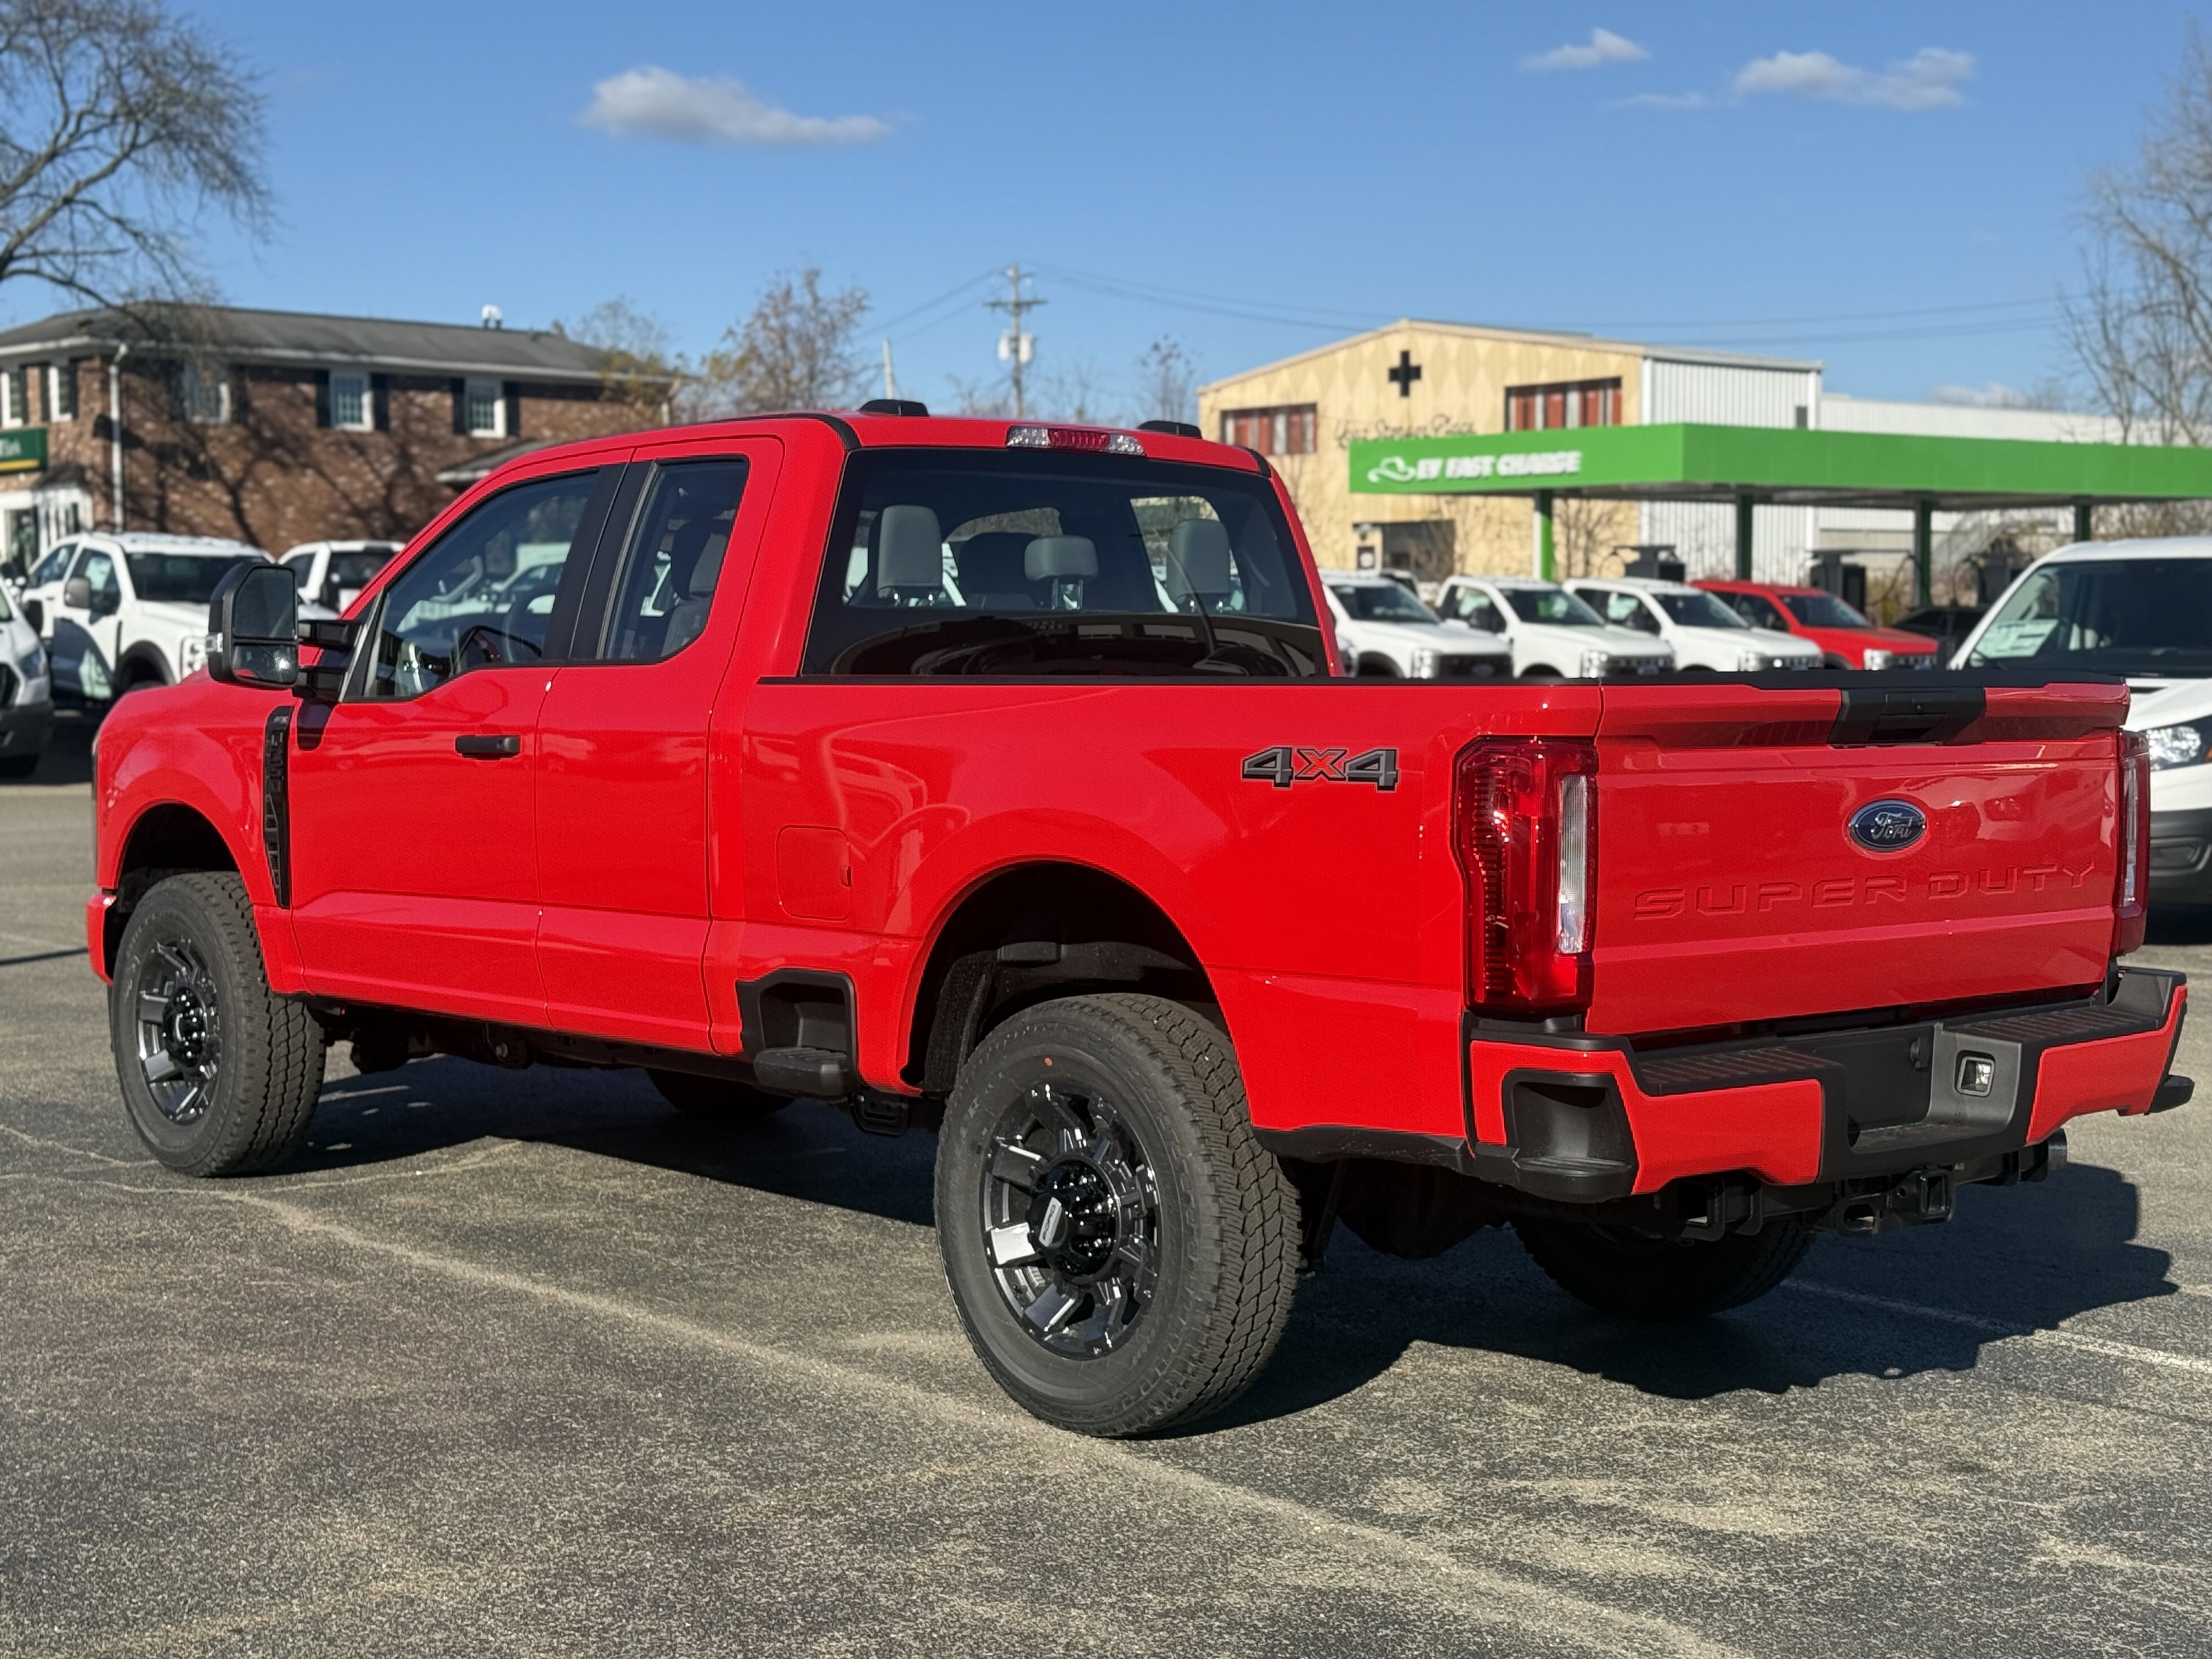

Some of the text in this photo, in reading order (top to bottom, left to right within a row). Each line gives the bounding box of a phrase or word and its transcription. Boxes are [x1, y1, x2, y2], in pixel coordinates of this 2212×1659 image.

[1416, 451, 1582, 480] EV FAST CHARGE
[1633, 861, 2095, 921] SUPER DUTY
